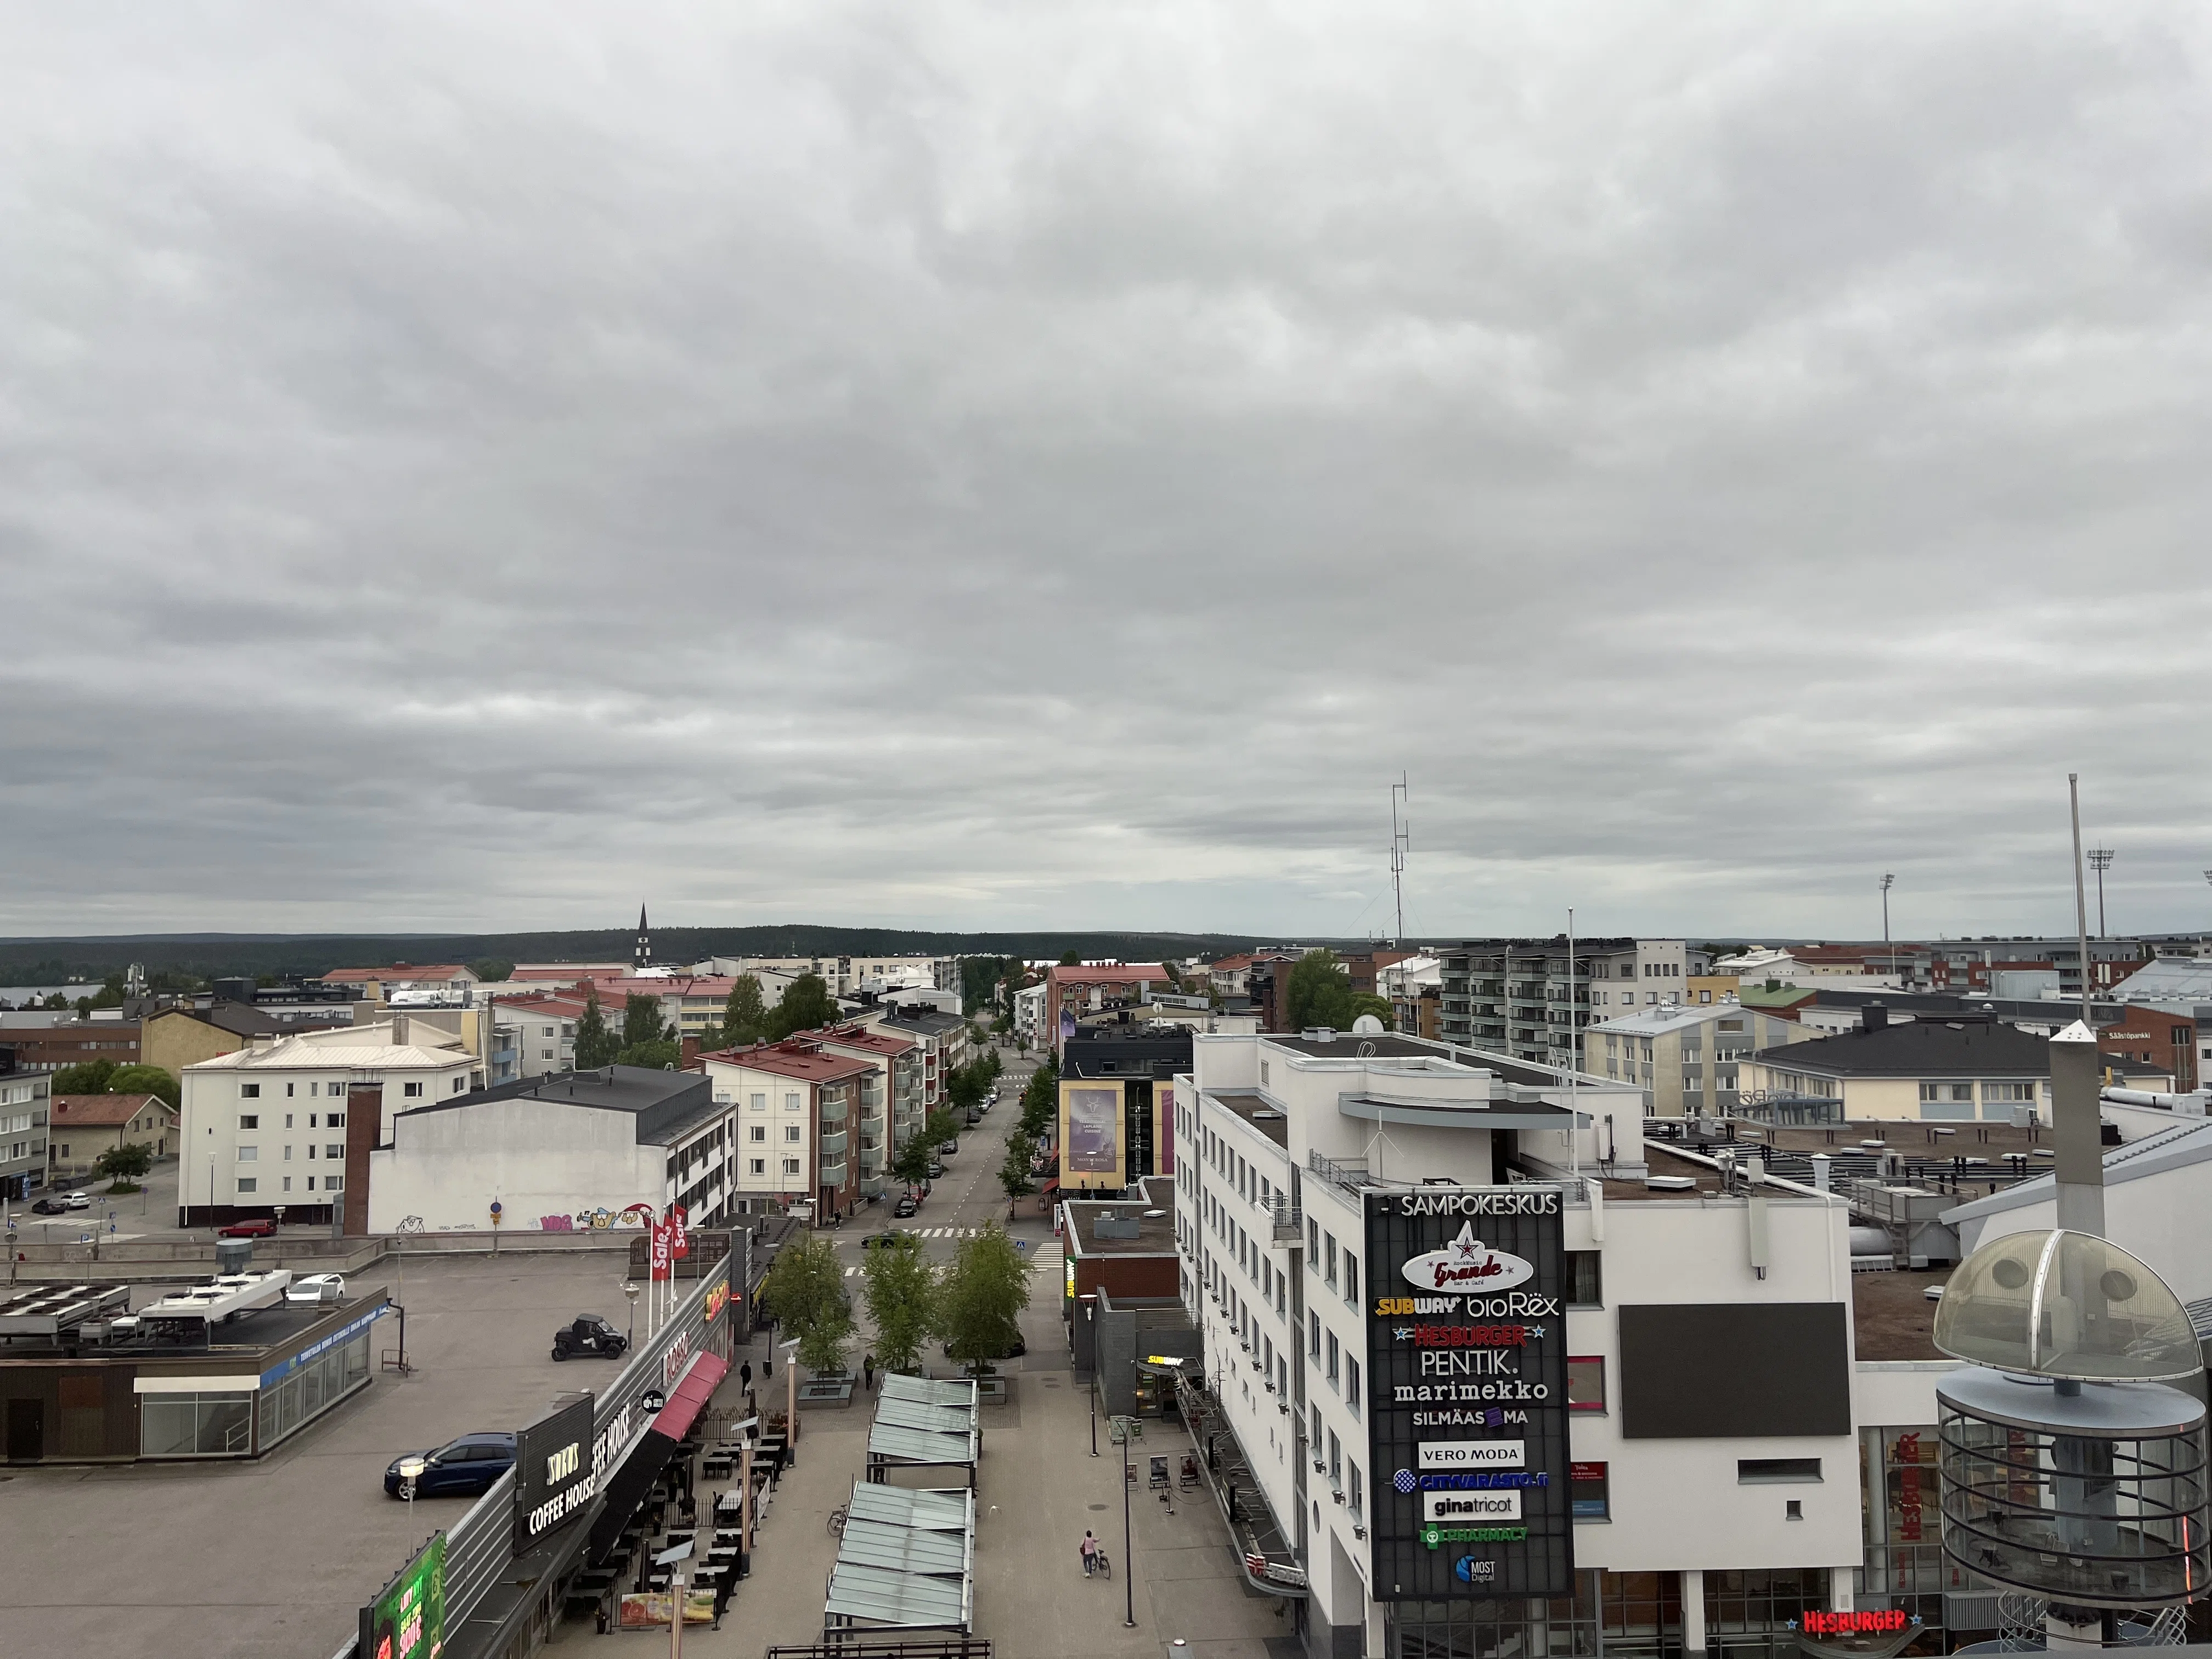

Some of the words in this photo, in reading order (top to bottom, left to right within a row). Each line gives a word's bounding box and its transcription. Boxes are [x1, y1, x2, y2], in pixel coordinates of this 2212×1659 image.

[2109, 1032, 2151, 1041] Säästöpankki
[1401, 1194, 1558, 1216] SAMPOKESKUS
[653, 1233, 669, 1269] Sale
[1066, 1259, 1075, 1299] SUBWAY
[1434, 1255, 1503, 1288] Grande
[1376, 1296, 1462, 1316] SUBWAY
[1414, 1324, 1527, 1347] HESBURGER
[663, 1331, 689, 1386] ROSSO
[1148, 1356, 1183, 1365] SUBWAY
[1421, 1350, 1519, 1376] PENTIK.
[1394, 1380, 1549, 1402] marimekko
[607, 1402, 630, 1464] HOUSE
[546, 1442, 579, 1486] SOKOS
[1424, 1450, 1466, 1461] VERO
[1470, 1449, 1519, 1460] MODA
[1420, 1472, 1549, 1489] CITYVARASTO.fi
[529, 1493, 564, 1535] COFFEE
[566, 1474, 595, 1513] HOUSE
[1435, 1497, 1512, 1516] ginatricot
[1446, 1527, 1528, 1542] PHARMACY
[1471, 1561, 1496, 1573] MOST
[1471, 1573, 1496, 1583] Digital
[1804, 1610, 1907, 1633] HESBURGER
